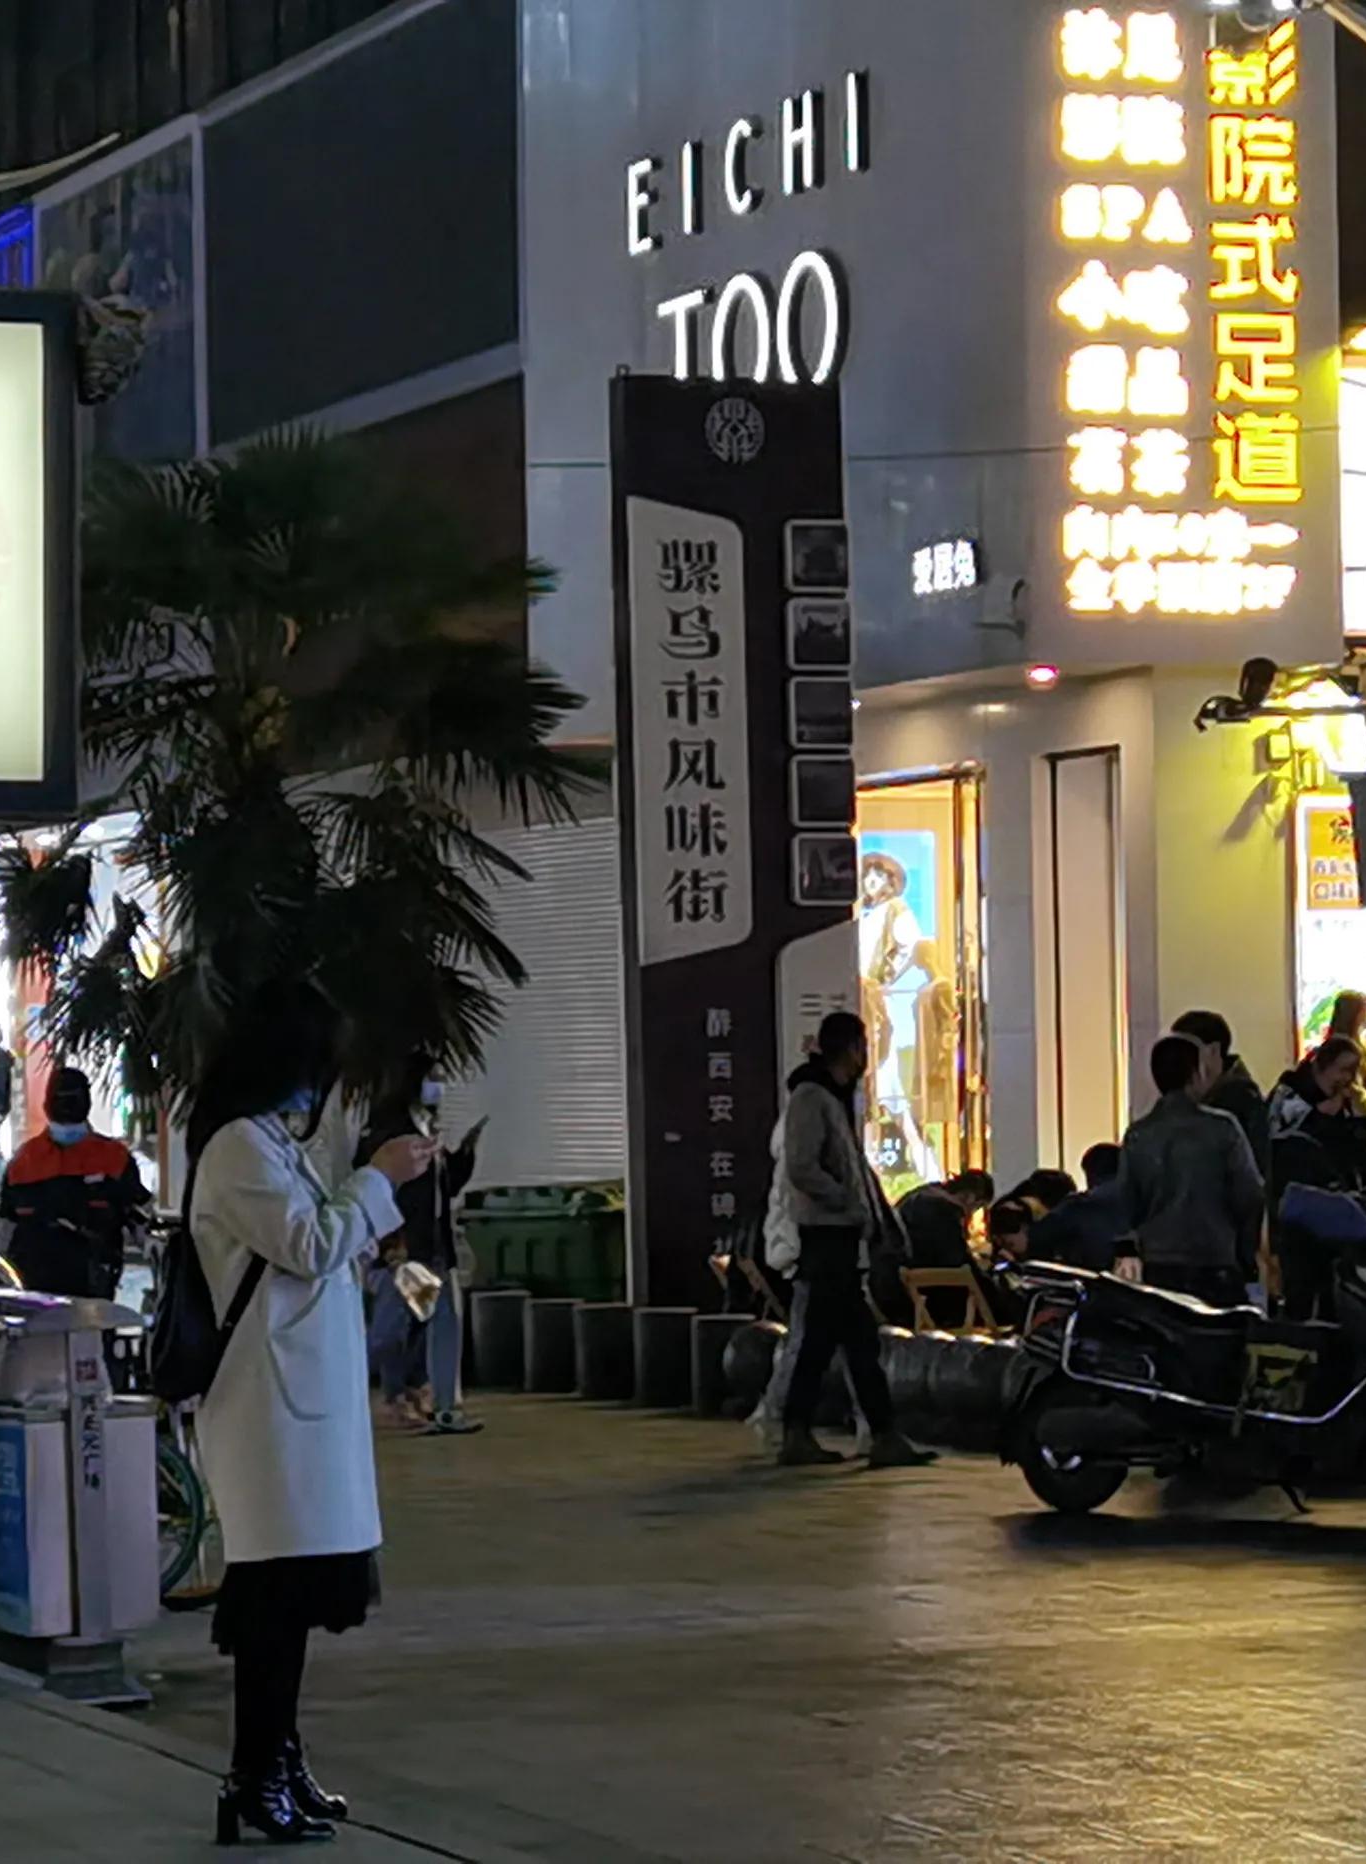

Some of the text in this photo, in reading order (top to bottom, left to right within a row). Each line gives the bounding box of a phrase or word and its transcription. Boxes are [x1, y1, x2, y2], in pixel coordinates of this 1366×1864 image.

[627, 71, 861, 257] EICHI
[1060, 182, 1194, 244] SPA
[657, 250, 839, 385] TOO
[1207, 18, 1302, 503] 影院式足道
[656, 537, 728, 925] 骡马市风味街
